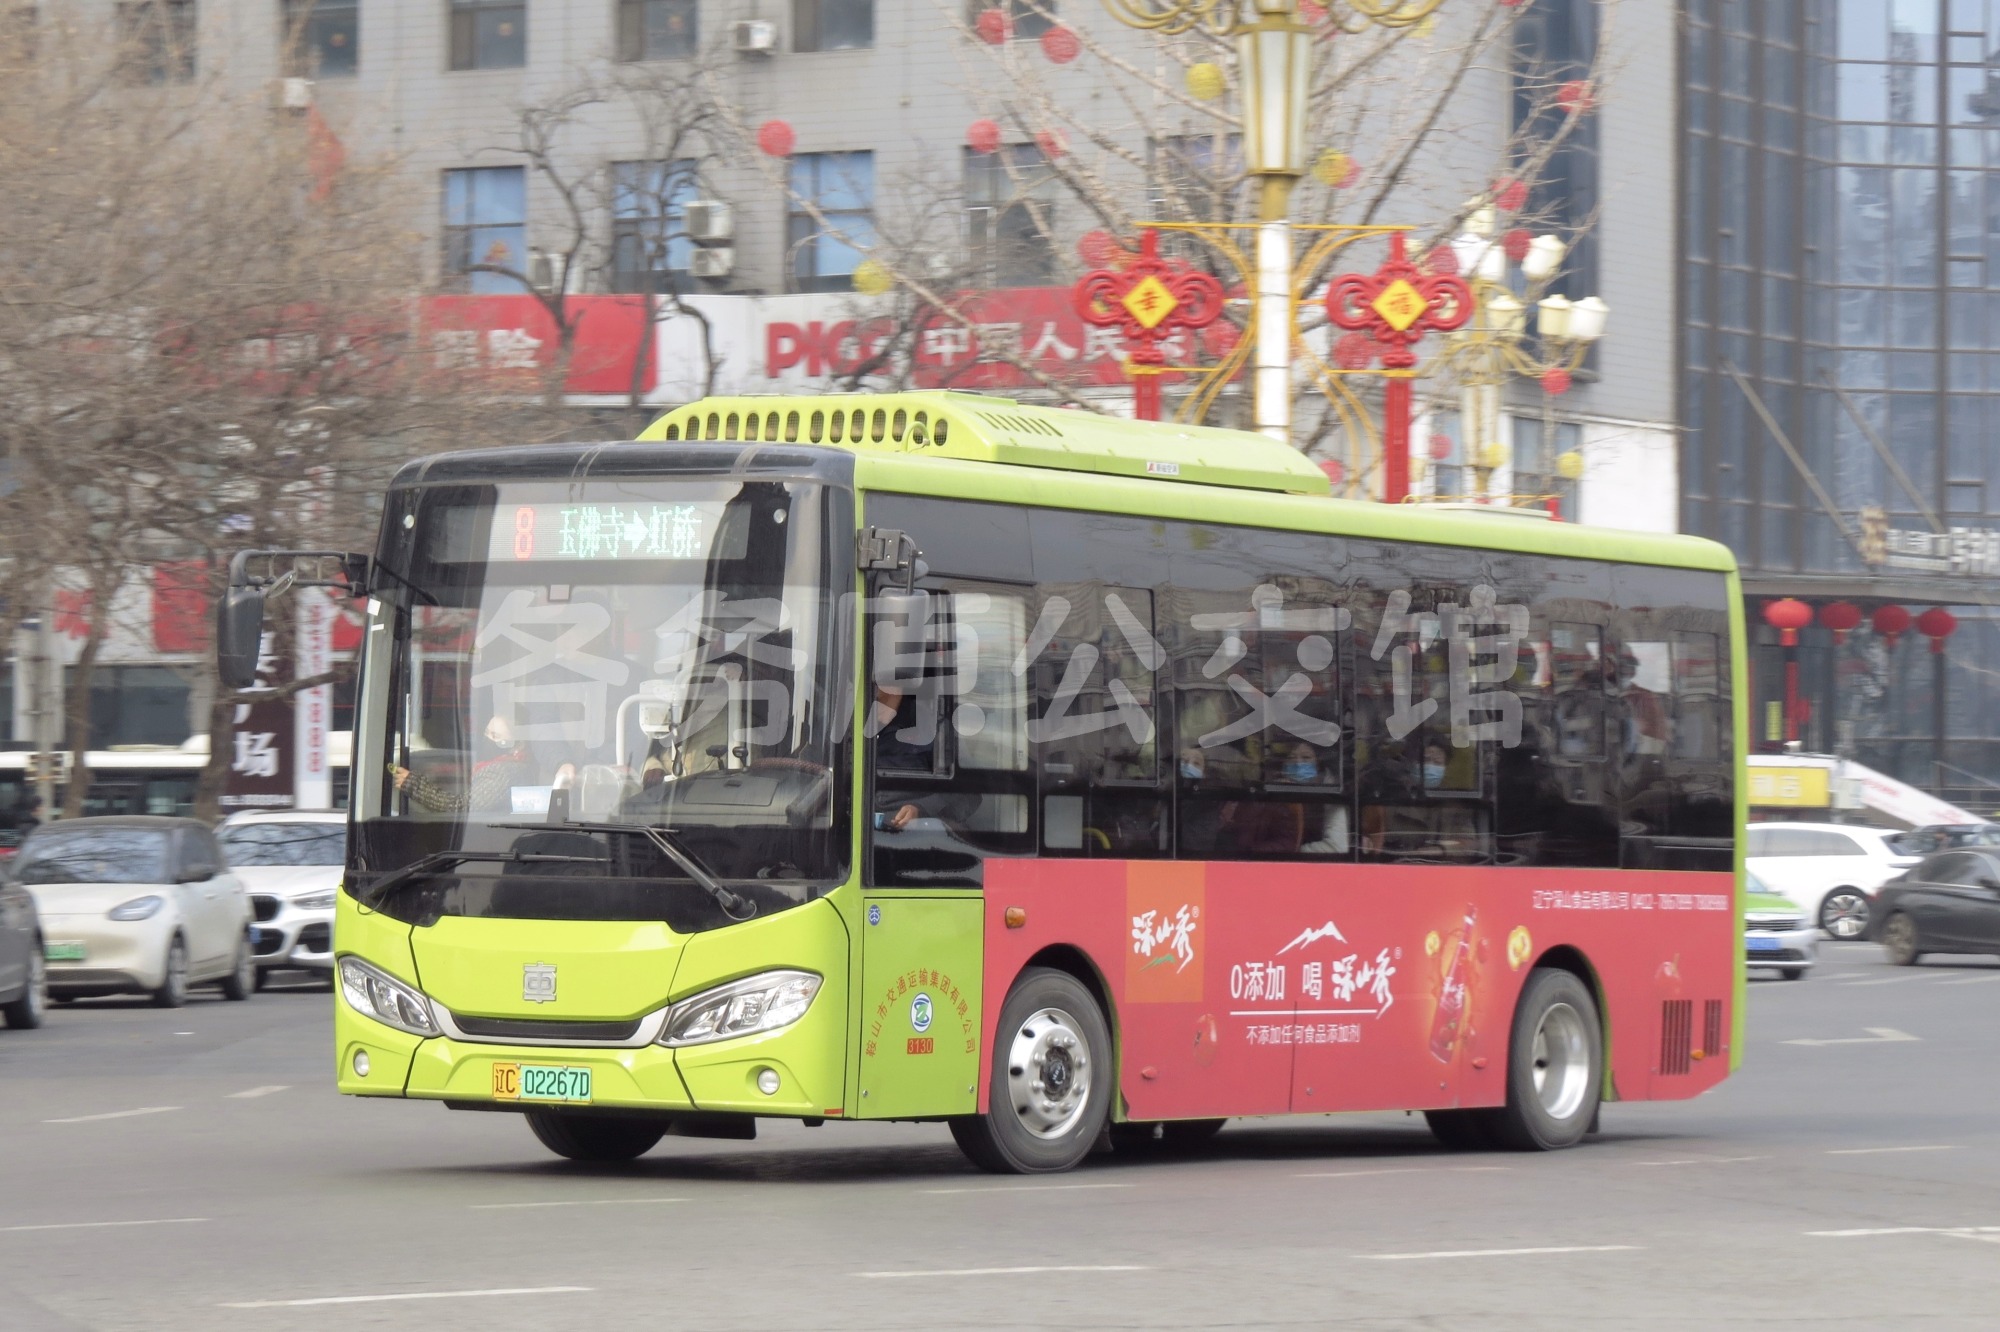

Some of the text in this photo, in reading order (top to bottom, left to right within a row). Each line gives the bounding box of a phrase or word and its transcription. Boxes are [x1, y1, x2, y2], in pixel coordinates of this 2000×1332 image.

[514, 507, 534, 558] 8
[1231, 962, 1286, 1001] 0添加
[1302, 961, 1322, 1000] 喝
[866, 968, 976, 1058] 鞍山市交通运输集团有限公司
[908, 1039, 933, 1053] 3130
[1246, 1024, 1361, 1045] 不添加任何食品添加剂
[495, 1069, 590, 1097] 辽C 02267D
